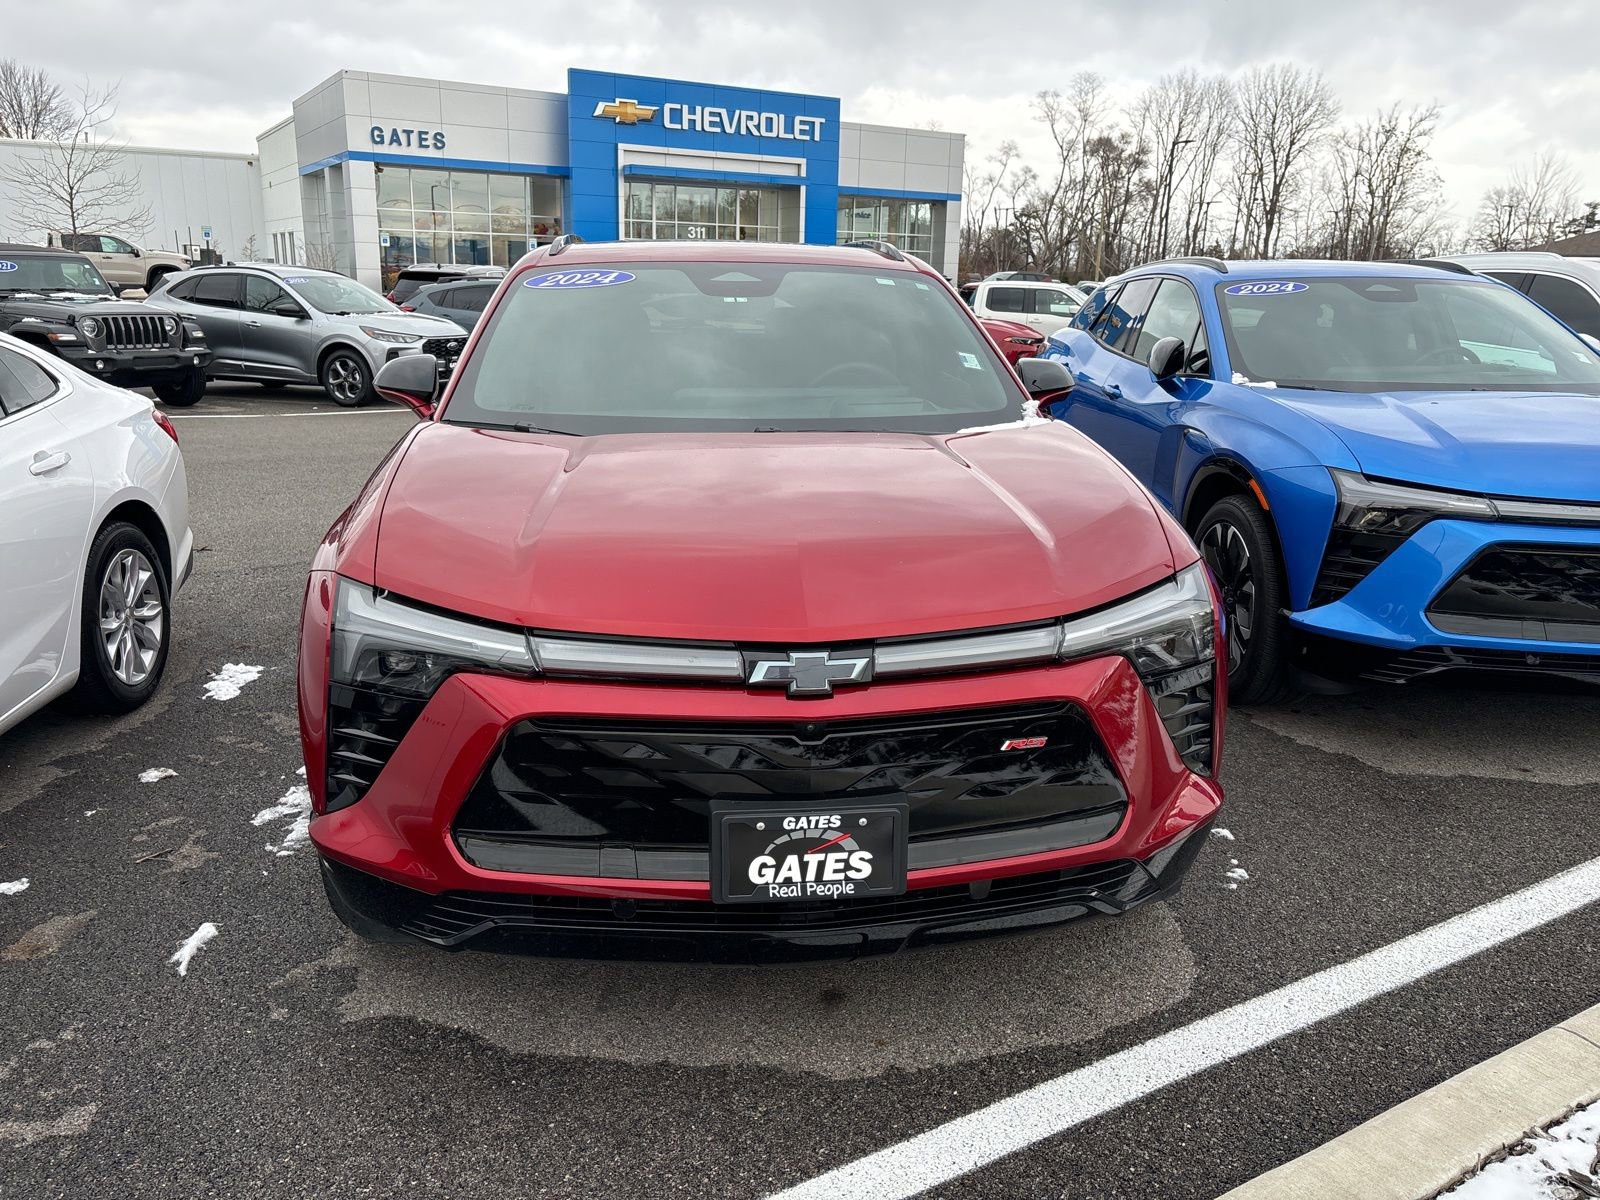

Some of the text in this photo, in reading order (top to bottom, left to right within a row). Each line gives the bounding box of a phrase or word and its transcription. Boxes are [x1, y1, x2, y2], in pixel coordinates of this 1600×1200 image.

[663, 102, 826, 142] CHEVROLET
[370, 125, 446, 150] GATES
[687, 226, 706, 239] 311
[538, 272, 620, 287] 2024
[1239, 282, 1296, 294] 2024
[1000, 737, 1048, 751] RS
[782, 815, 842, 830] GATES
[748, 850, 873, 885] GATES
[769, 880, 855, 899] Real People
